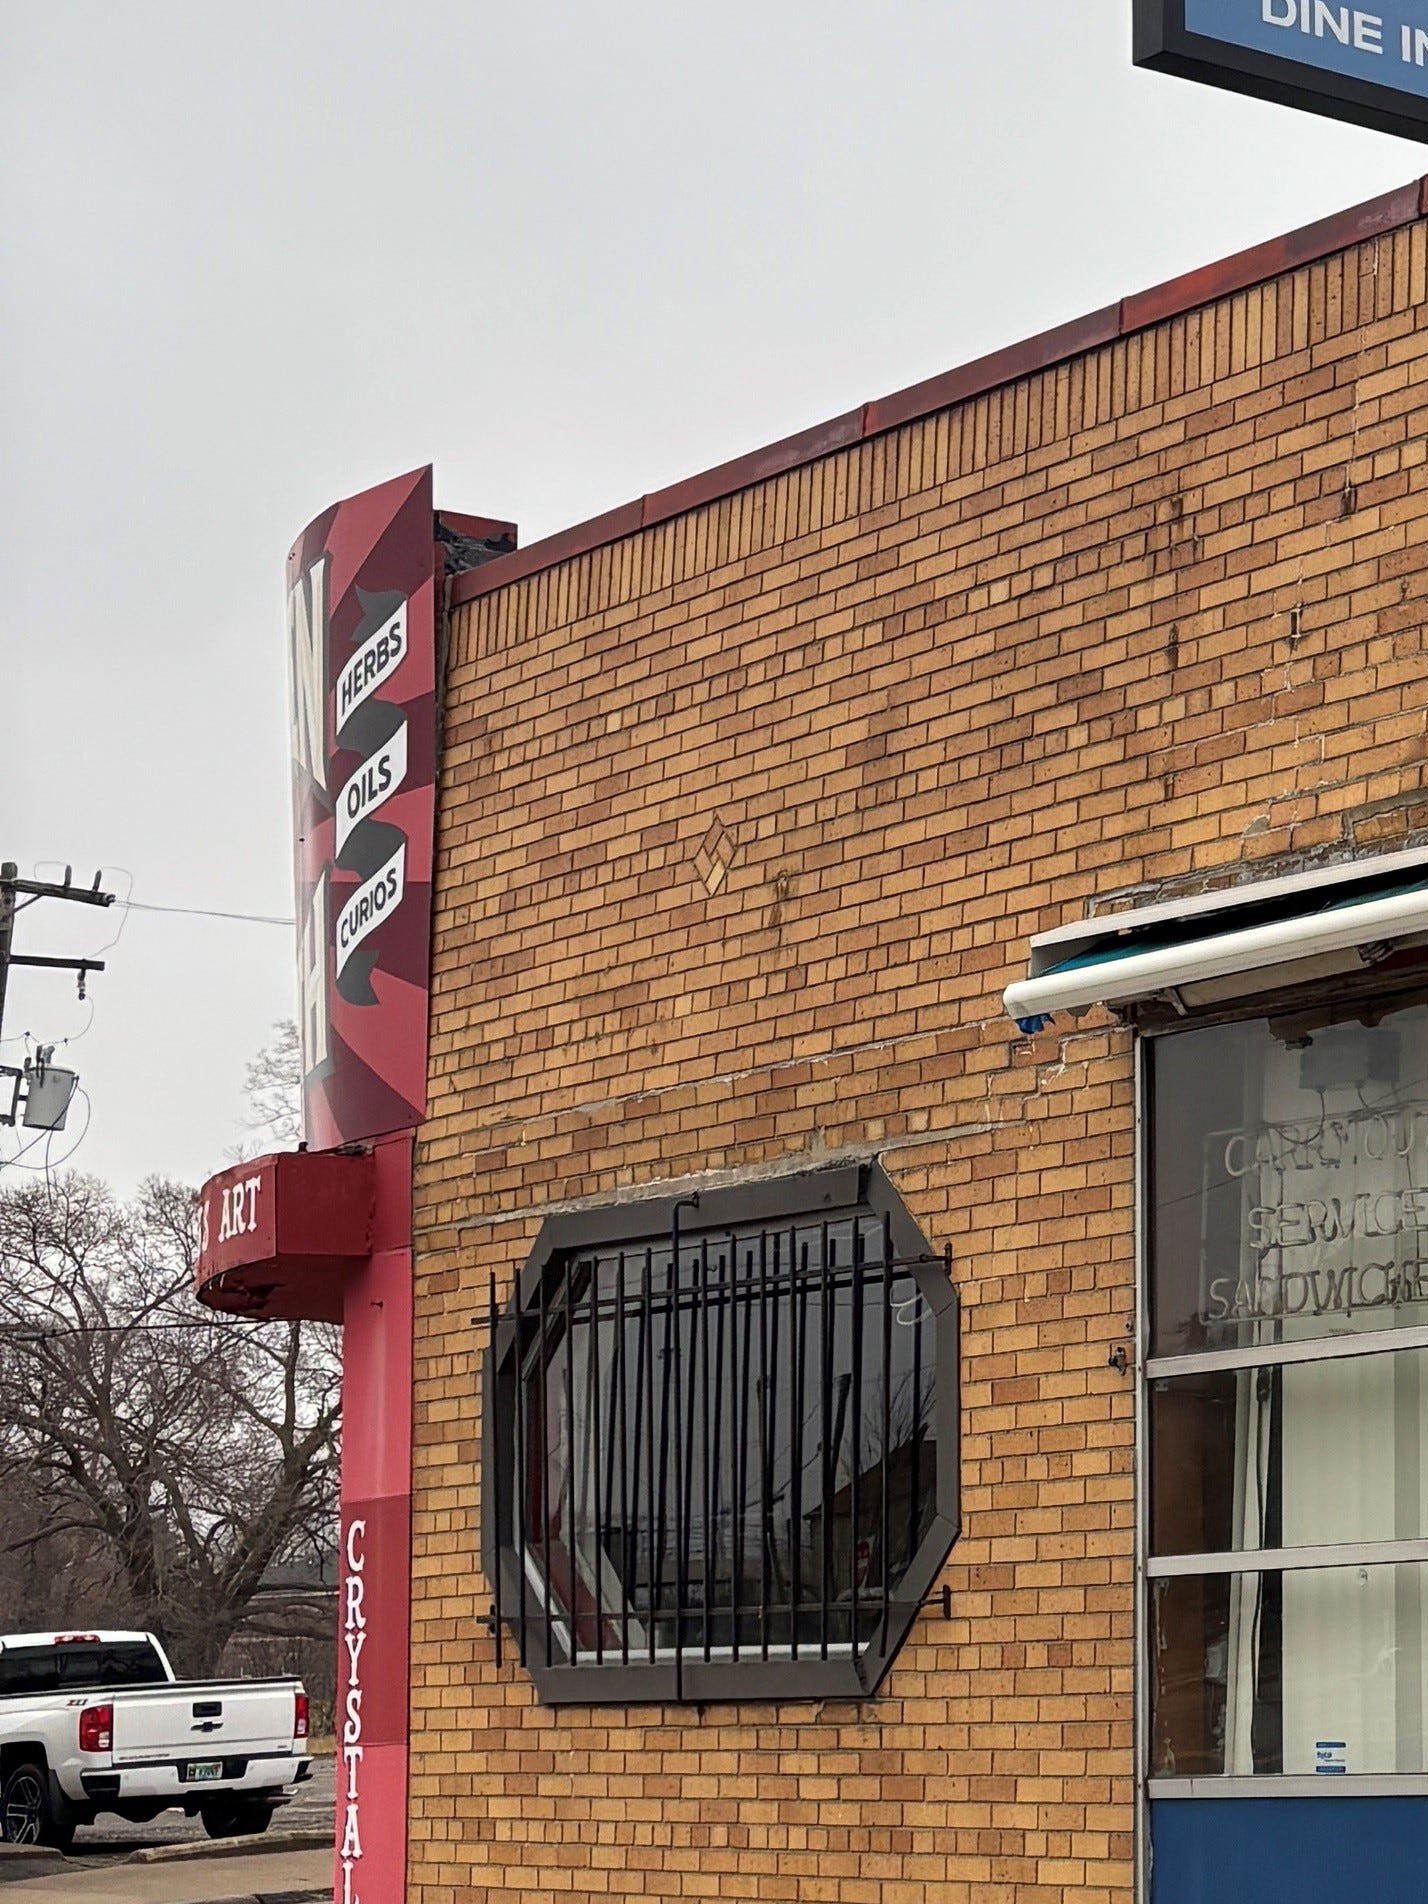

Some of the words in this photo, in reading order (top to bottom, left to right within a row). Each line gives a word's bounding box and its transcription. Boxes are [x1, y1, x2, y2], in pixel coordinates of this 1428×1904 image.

[342, 621, 402, 717] HERBS
[347, 754, 391, 819] OILS
[341, 867, 396, 948] CURIOS
[217, 1175, 262, 1243] ART
